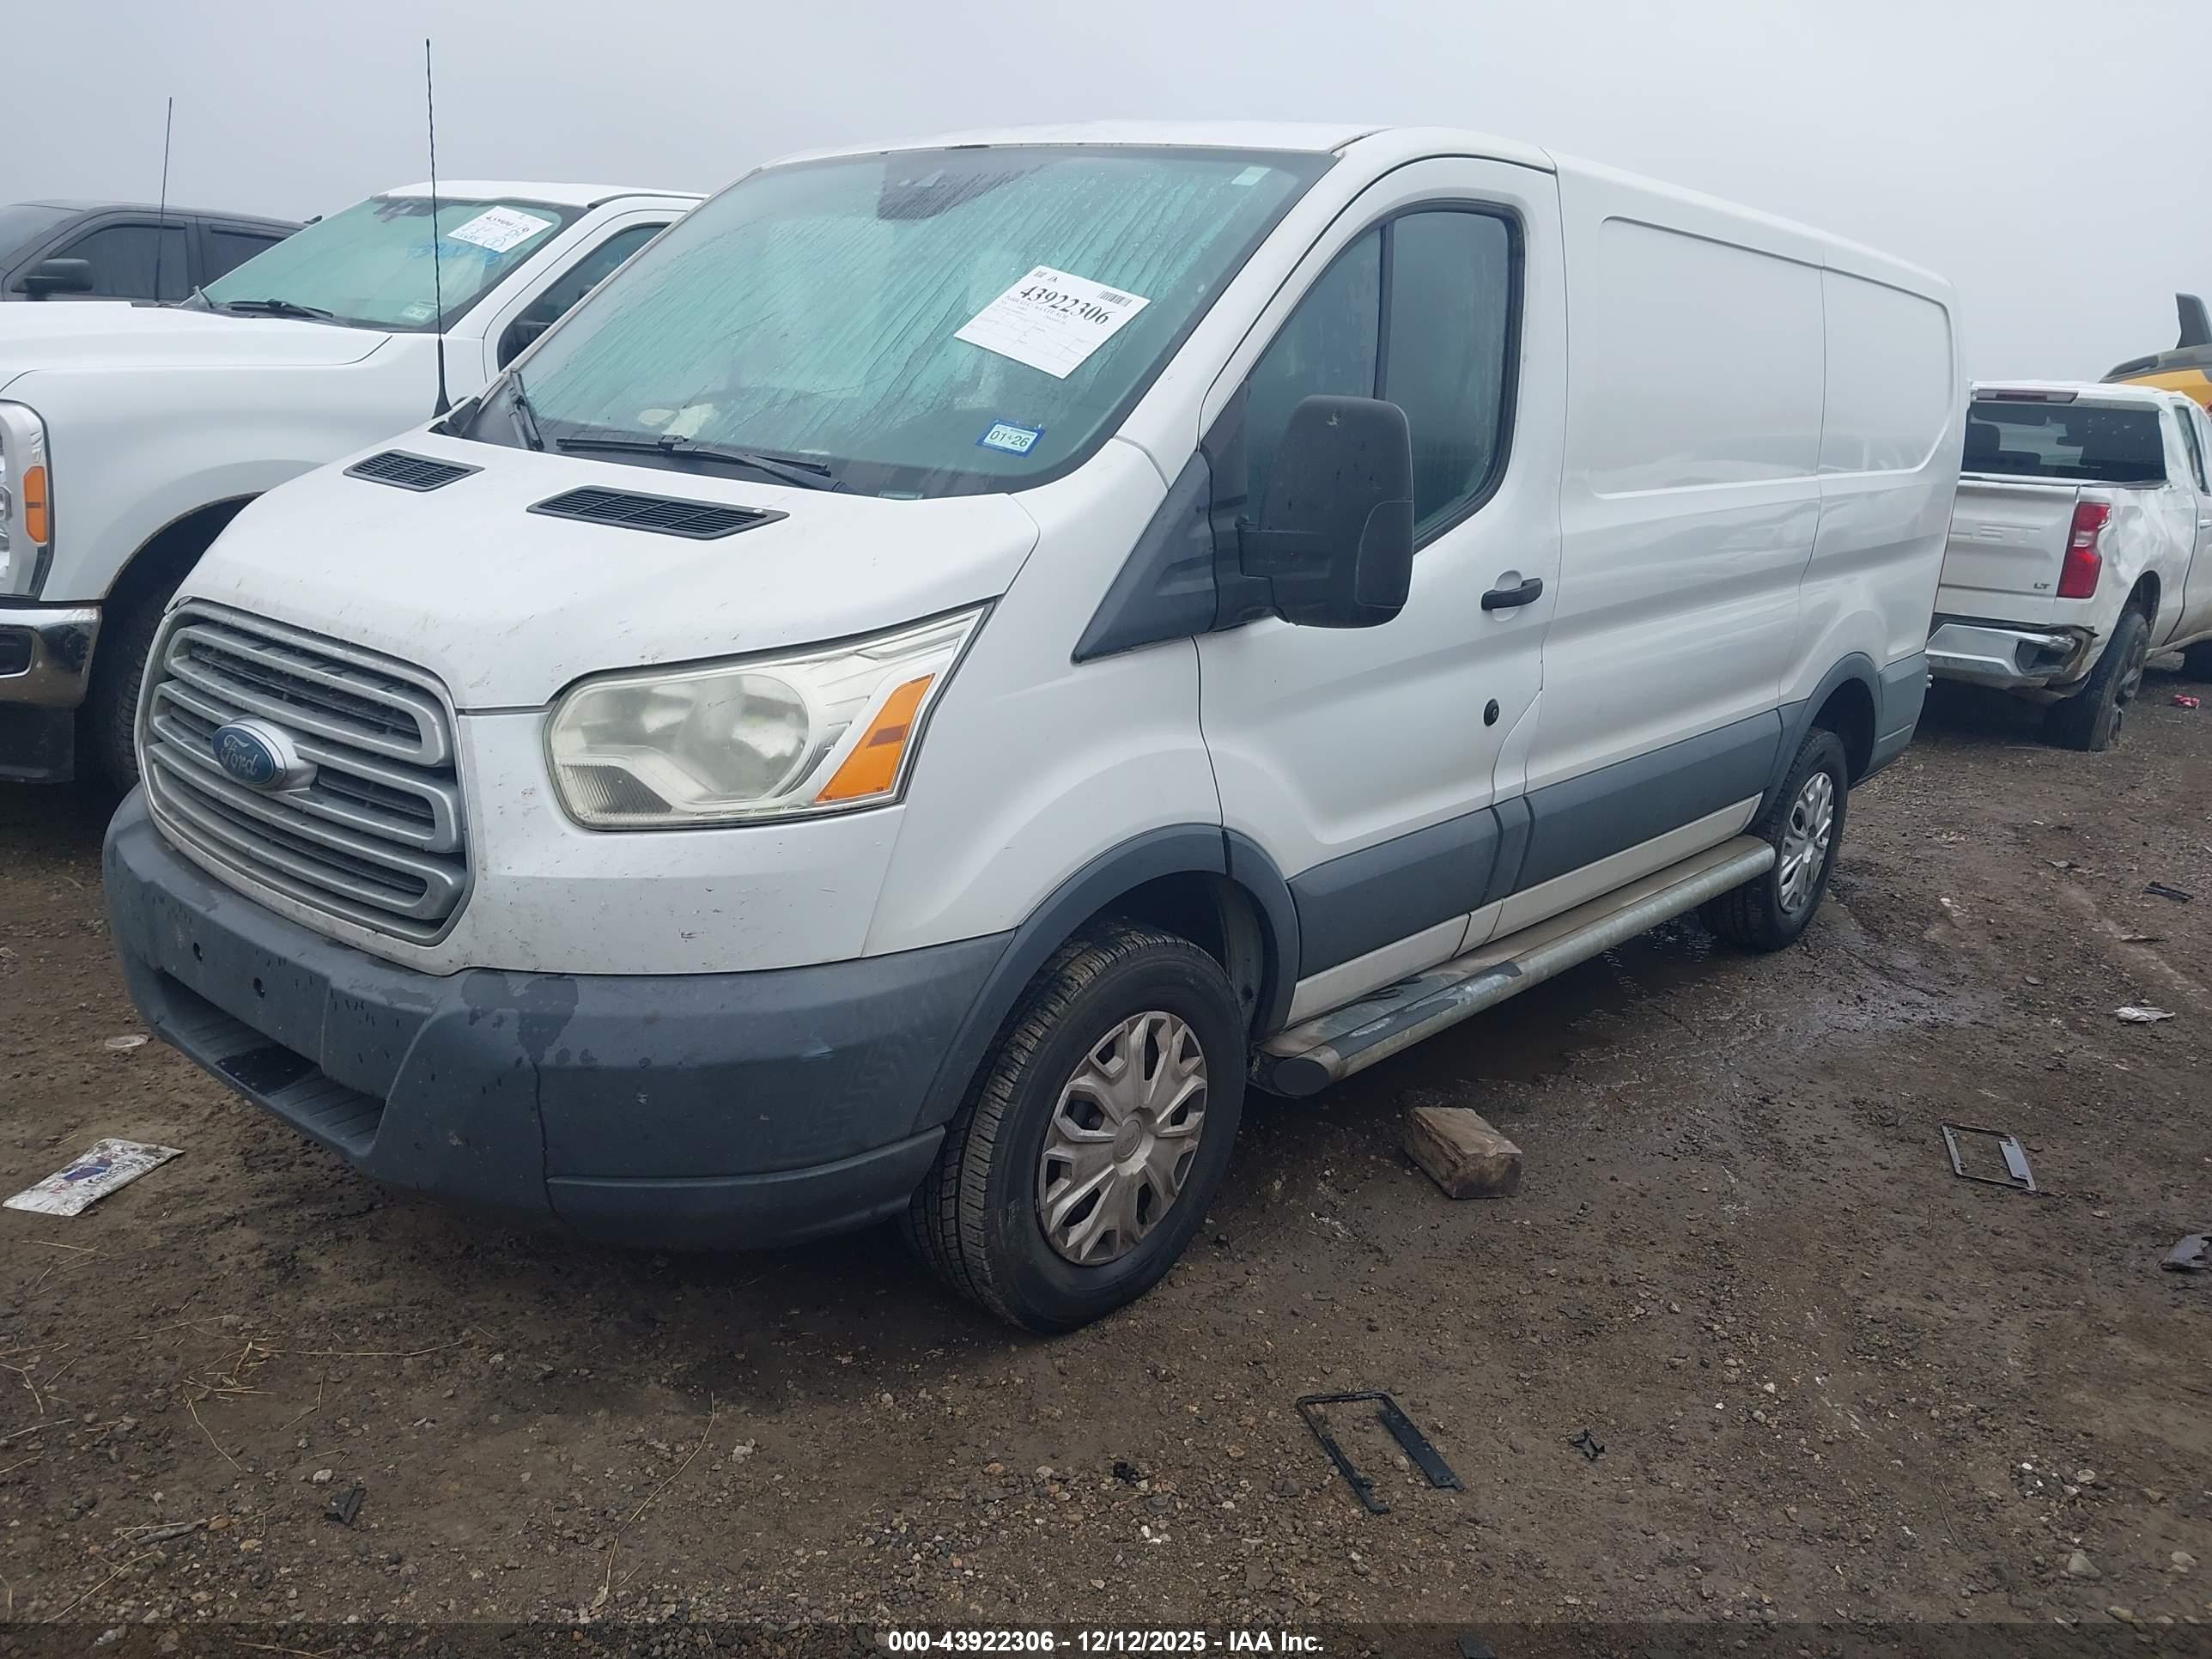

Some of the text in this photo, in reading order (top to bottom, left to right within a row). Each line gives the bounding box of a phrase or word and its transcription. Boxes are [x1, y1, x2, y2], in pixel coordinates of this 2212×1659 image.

[1020, 286, 1116, 325] 43922306
[989, 430, 1007, 442] 01
[1011, 435, 1030, 447] 26
[220, 734, 259, 775] Ford
